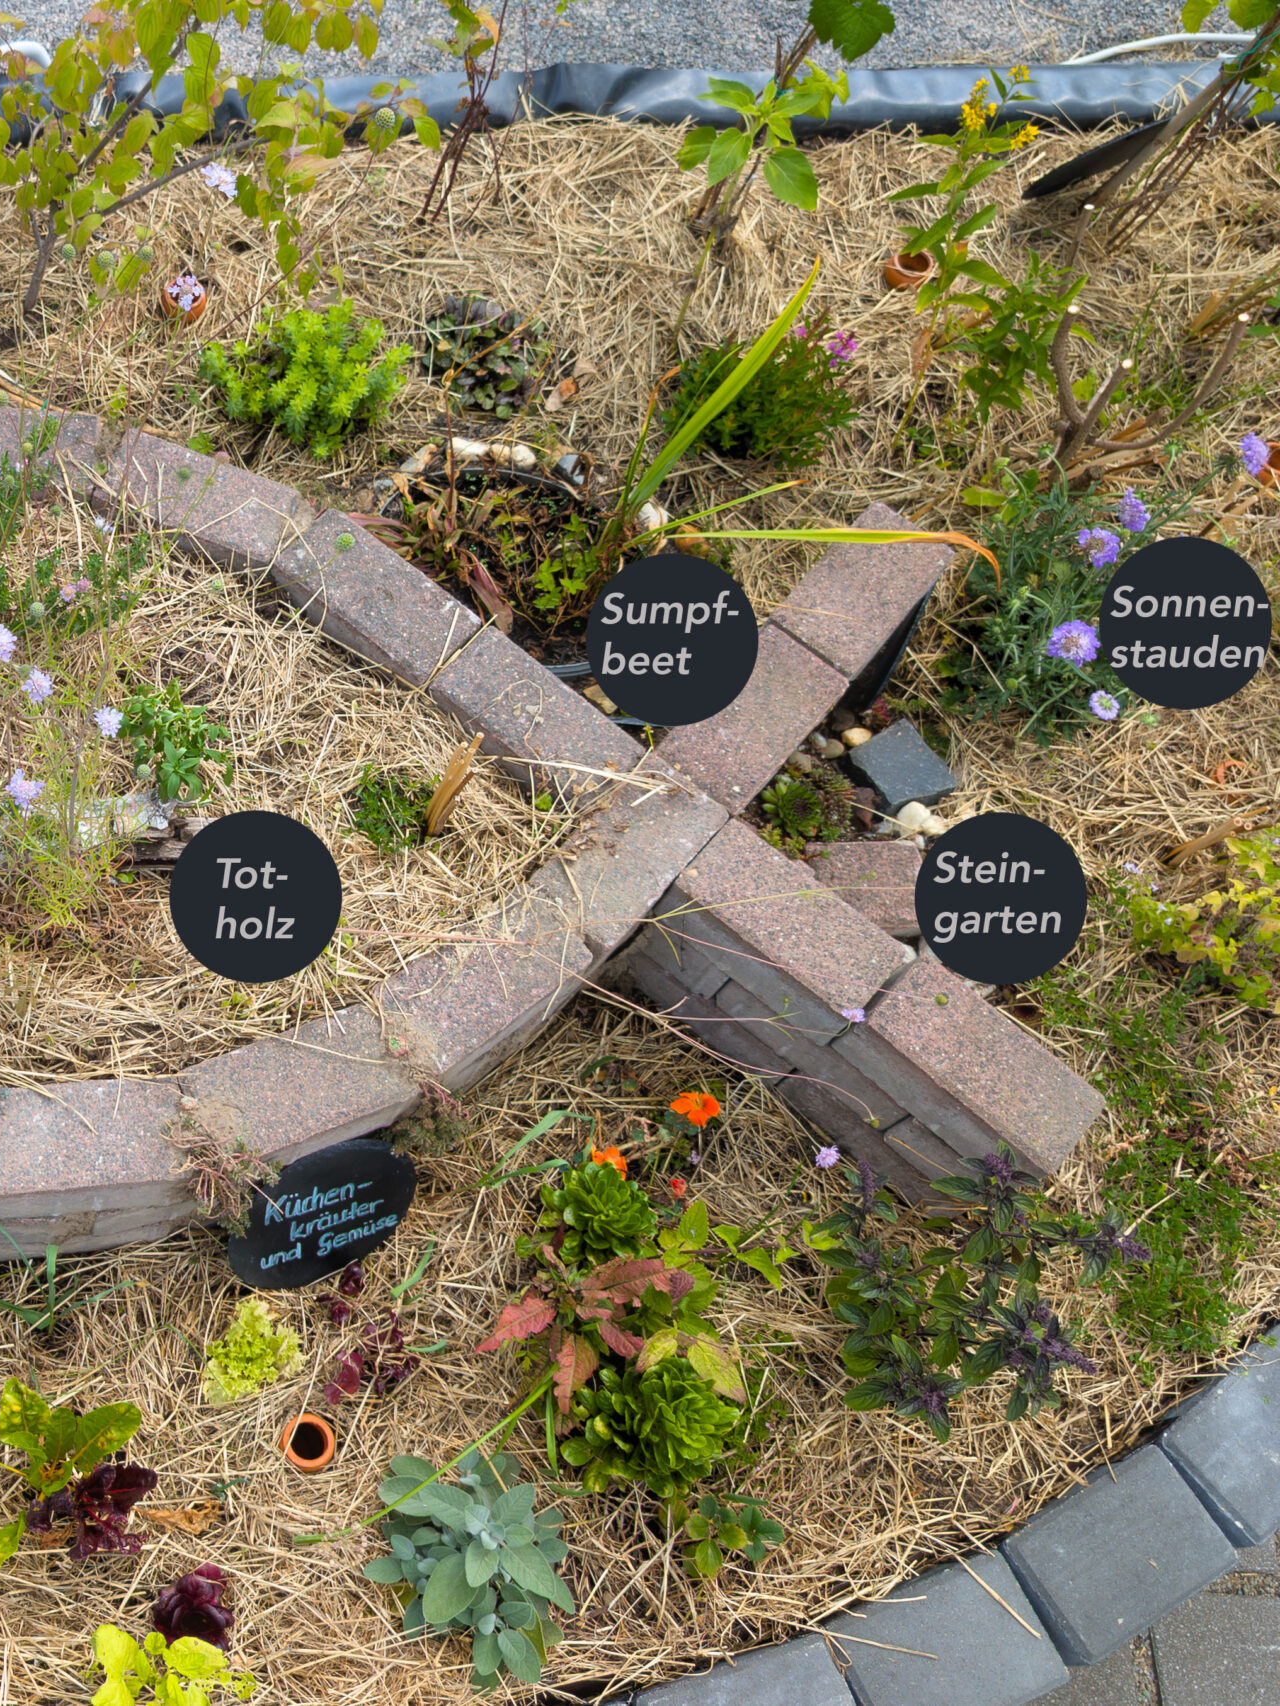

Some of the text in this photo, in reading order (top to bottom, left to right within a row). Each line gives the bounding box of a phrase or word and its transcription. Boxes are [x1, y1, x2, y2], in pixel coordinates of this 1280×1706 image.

[264, 1181, 373, 1226] Küchen-
[289, 1199, 384, 1241] kräuter
[260, 1213, 399, 1270] und Gemüse
